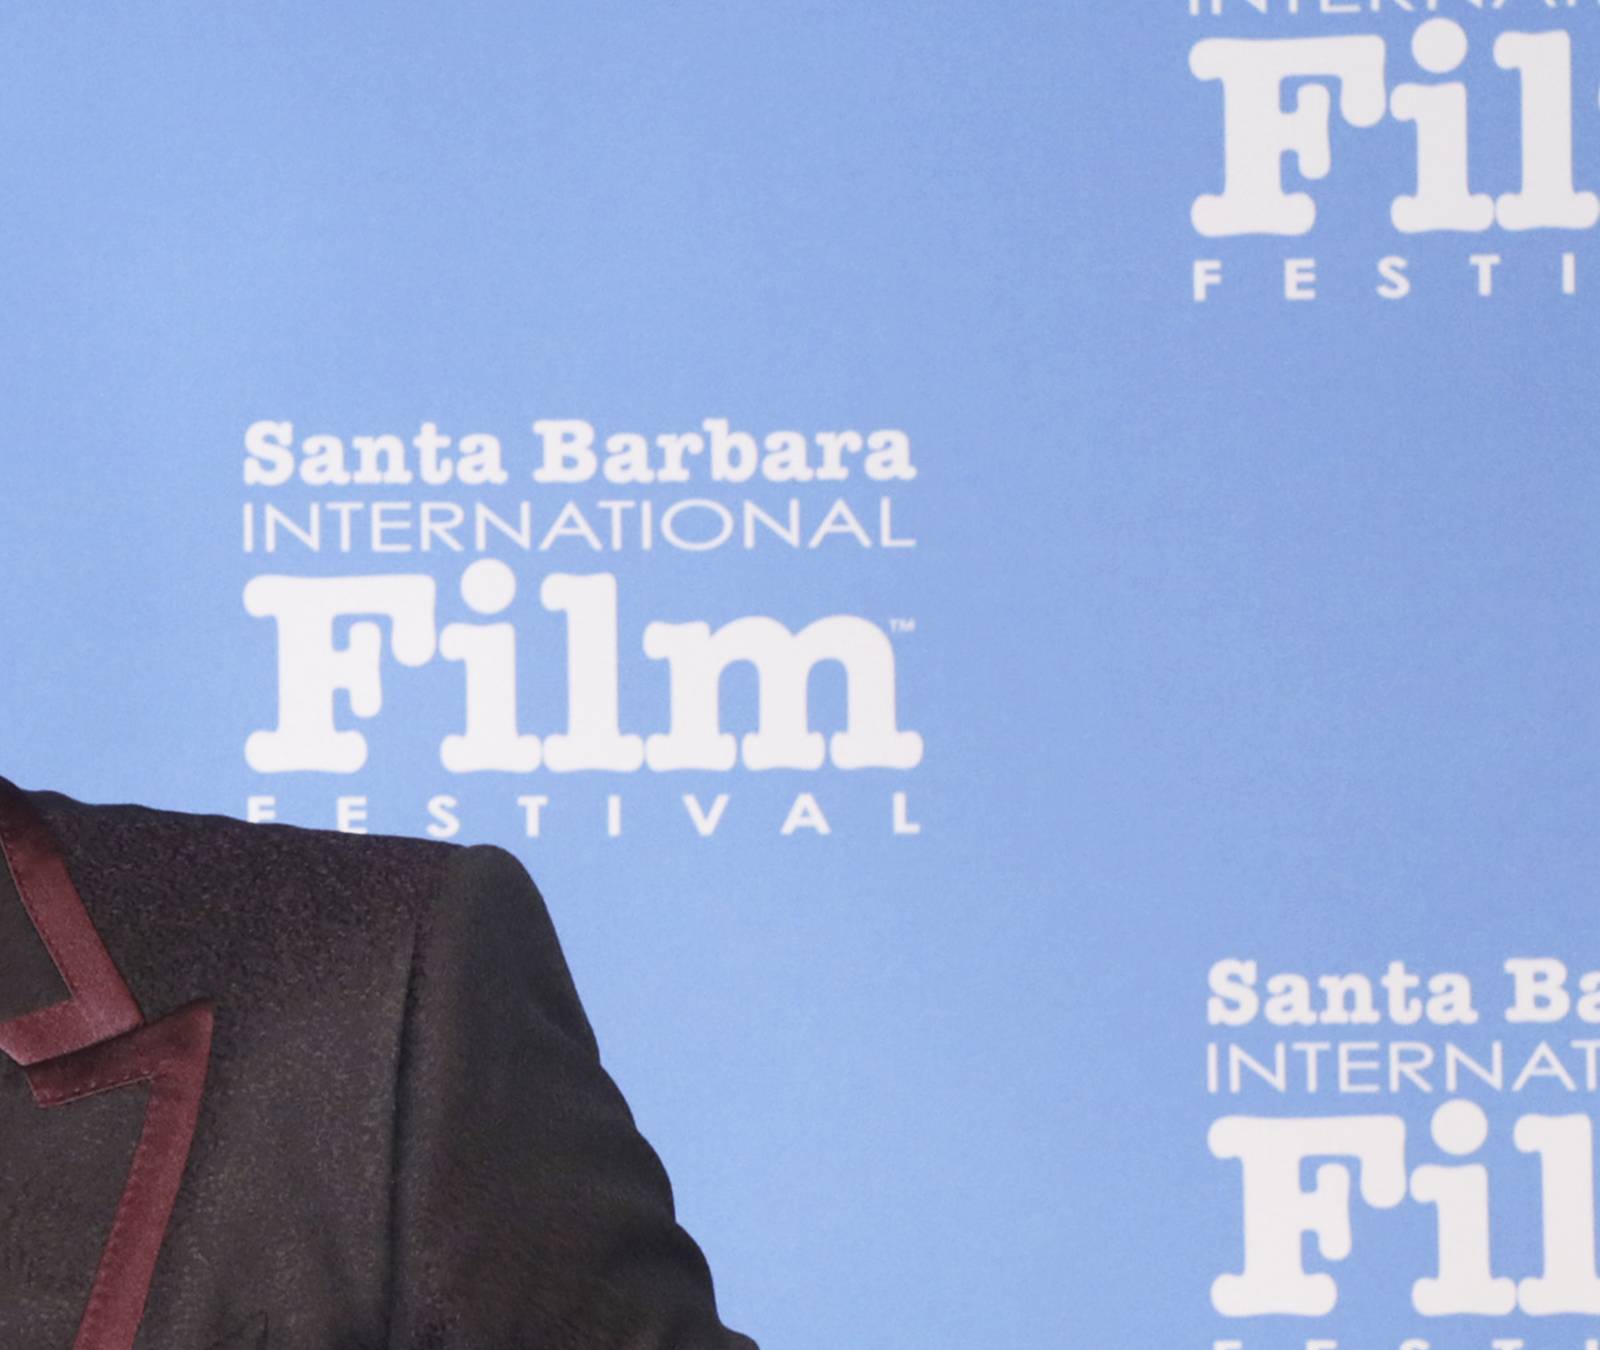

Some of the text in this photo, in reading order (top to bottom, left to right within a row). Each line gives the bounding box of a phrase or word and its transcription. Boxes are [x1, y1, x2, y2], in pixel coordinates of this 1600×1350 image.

[1187, 16, 1600, 238] Fil
[1192, 251, 1577, 302] FESTI
[242, 416, 919, 488] Santa Barbara
[242, 495, 917, 555] INTERNATIONAL
[242, 556, 926, 776] Film
[245, 790, 922, 840] FESTIVAL
[1206, 957, 1481, 1026] Santa
[1206, 1038, 1600, 1095] INTERNAT
[1206, 1097, 1600, 1319] Fil
